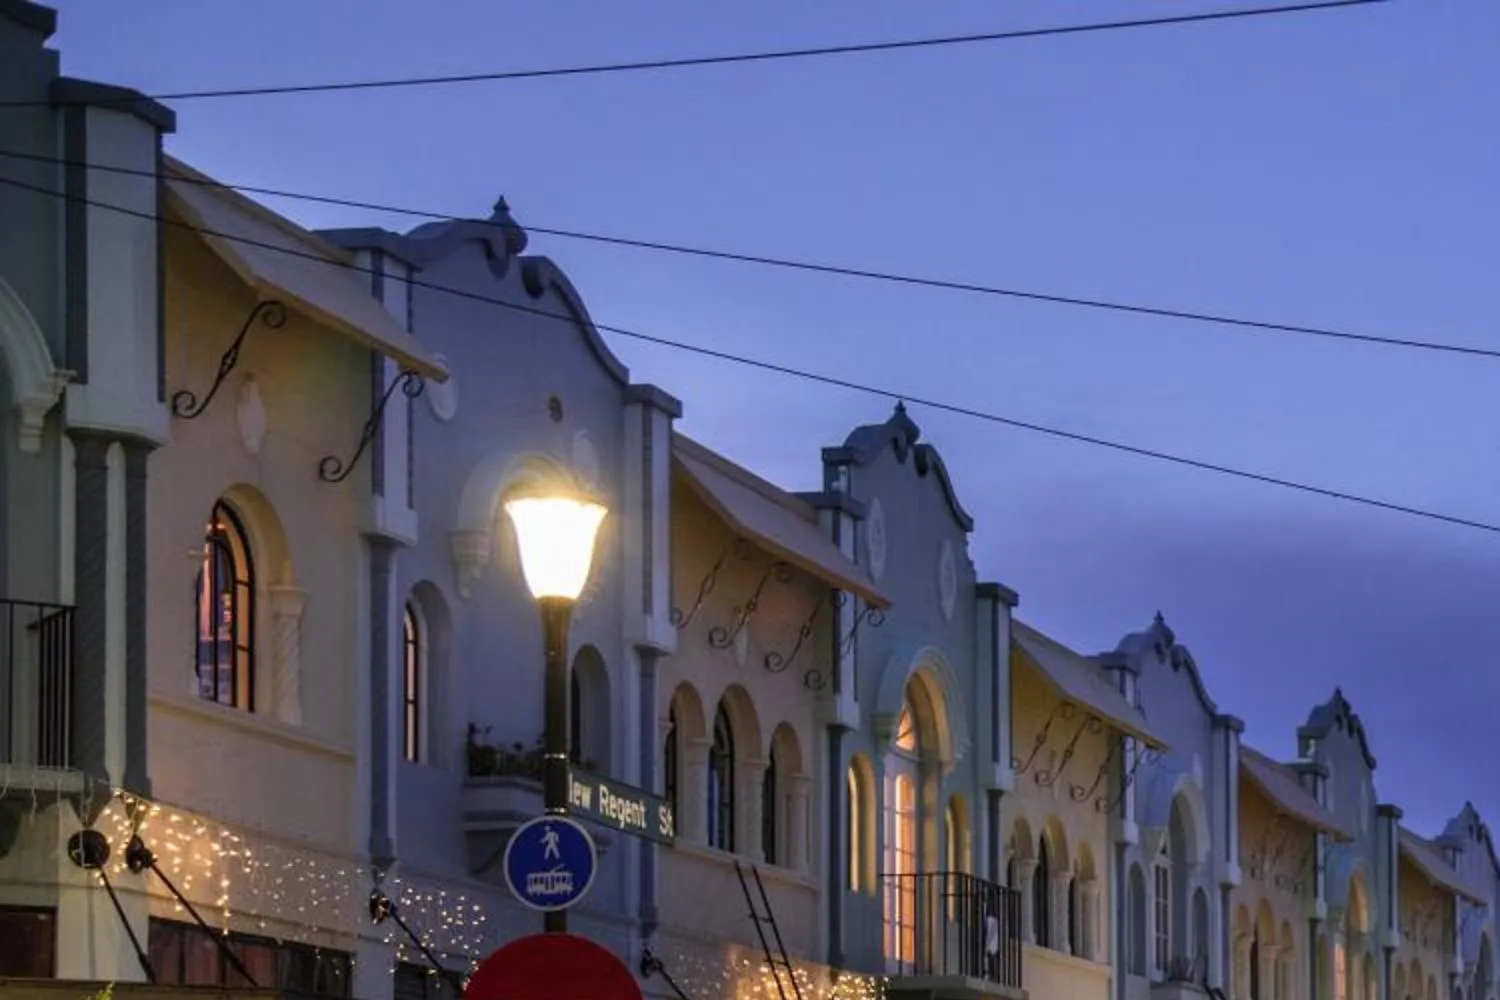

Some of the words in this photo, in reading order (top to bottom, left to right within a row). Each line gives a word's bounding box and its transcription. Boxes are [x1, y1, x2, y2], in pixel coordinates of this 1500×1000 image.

[568, 773, 592, 810] ew
[599, 783, 646, 829] Regent
[658, 804, 674, 838] St
